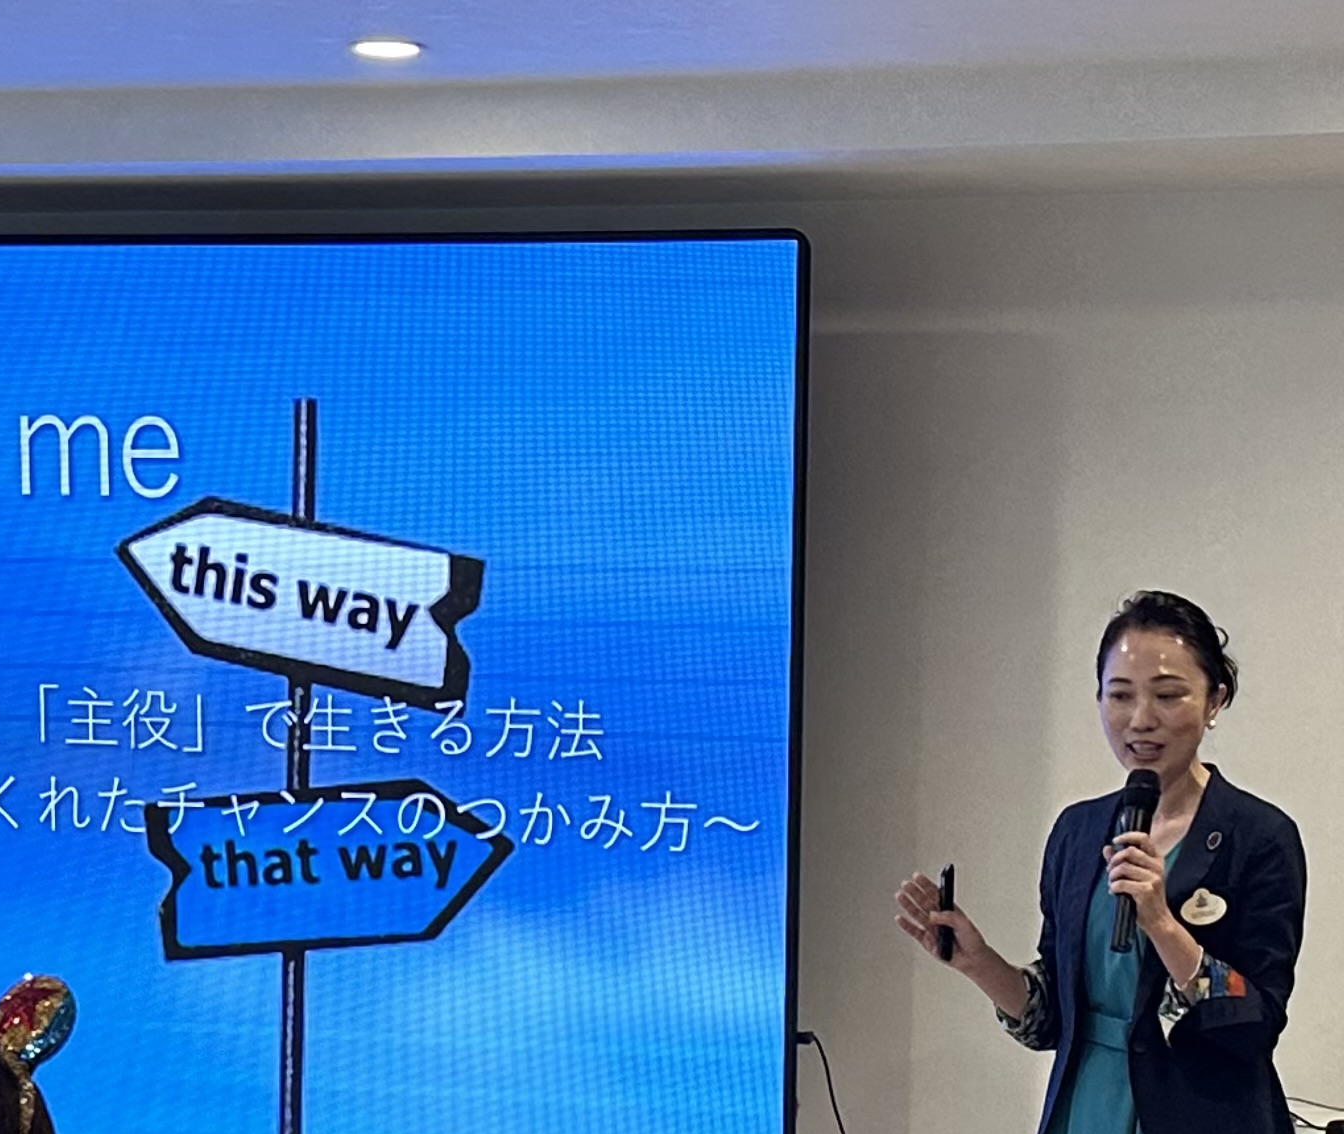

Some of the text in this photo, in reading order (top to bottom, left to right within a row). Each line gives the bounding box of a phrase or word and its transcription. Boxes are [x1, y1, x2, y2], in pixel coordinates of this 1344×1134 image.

[19, 414, 181, 499] me
[170, 543, 420, 651] this way
[199, 837, 459, 890] that way
